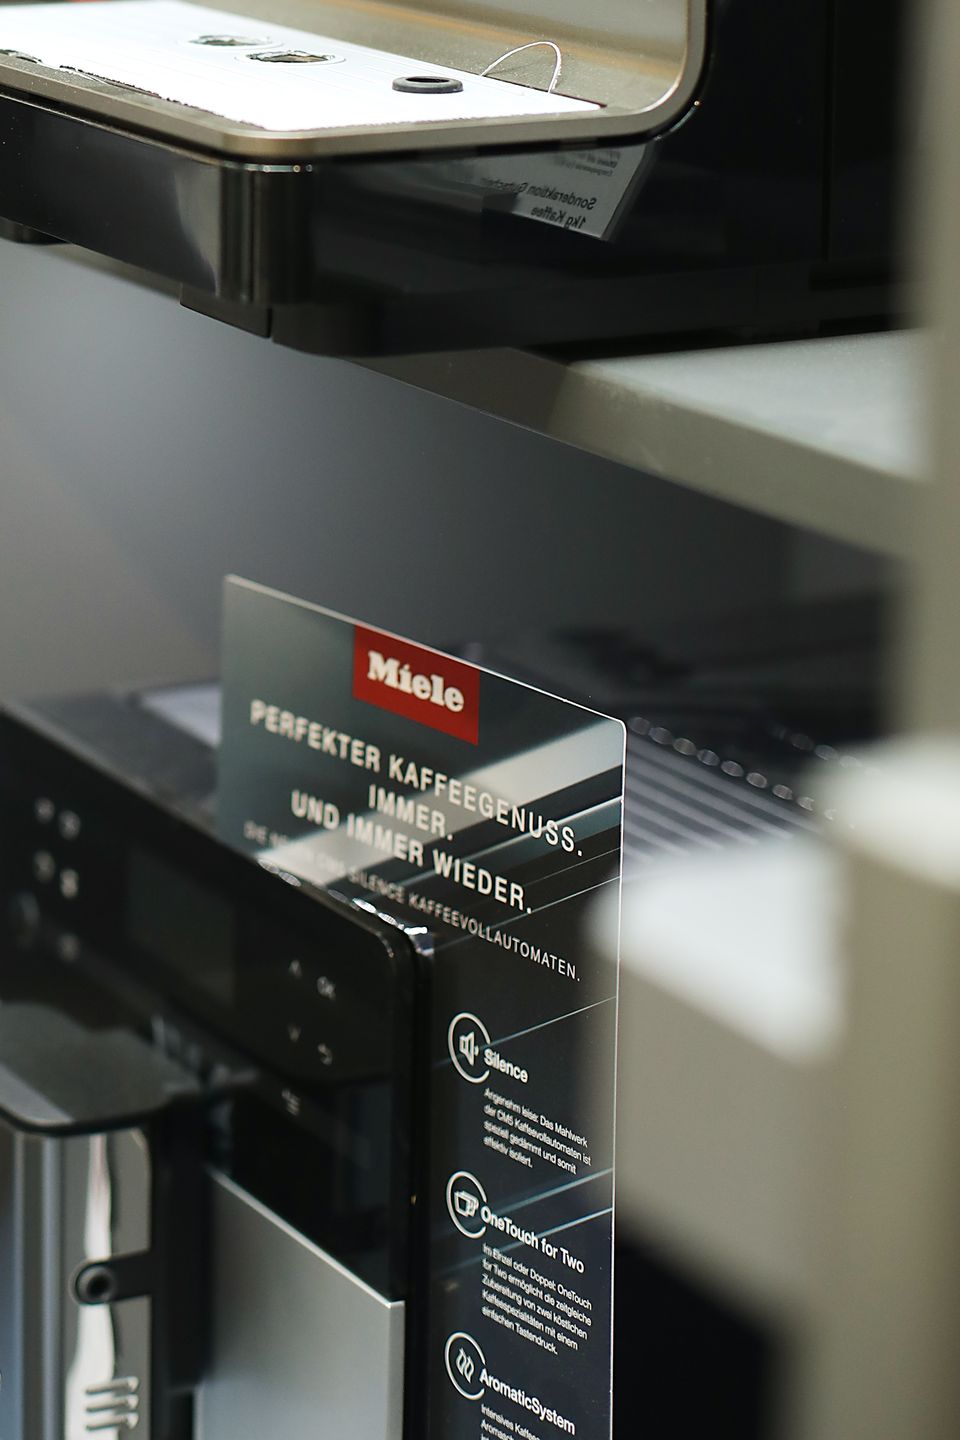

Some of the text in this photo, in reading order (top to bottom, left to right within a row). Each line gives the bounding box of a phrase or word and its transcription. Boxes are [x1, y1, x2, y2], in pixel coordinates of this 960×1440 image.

[367, 650, 464, 712] Miele
[250, 699, 381, 772] PERFEKTER
[389, 754, 583, 856] KAFFEEGENUSS.
[368, 784, 453, 841] IMMER.
[291, 789, 339, 828] UND
[347, 813, 424, 866] IMMER
[433, 849, 532, 914] WIEDER.
[408, 891, 581, 981] KAFFEEVOLLAUTOMATEN.
[483, 1047, 529, 1083] Silence
[540, 1115, 554, 1130] Das
[555, 1122, 588, 1148] Mahlwerk
[542, 1149, 556, 1164] und
[557, 1158, 577, 1175] somit
[480, 1205, 585, 1274] OneTouch for Two
[513, 1261, 529, 1276] oder
[557, 1284, 592, 1311] OneTouch
[544, 1293, 555, 1306] die
[556, 1300, 592, 1326] zeitgleiche
[523, 1297, 536, 1310] von
[536, 1305, 553, 1320] zwei
[553, 1312, 588, 1340] köstlichen
[544, 1325, 556, 1339] mit
[556, 1332, 578, 1350] einem
[479, 1367, 576, 1436] AromaticSystem
